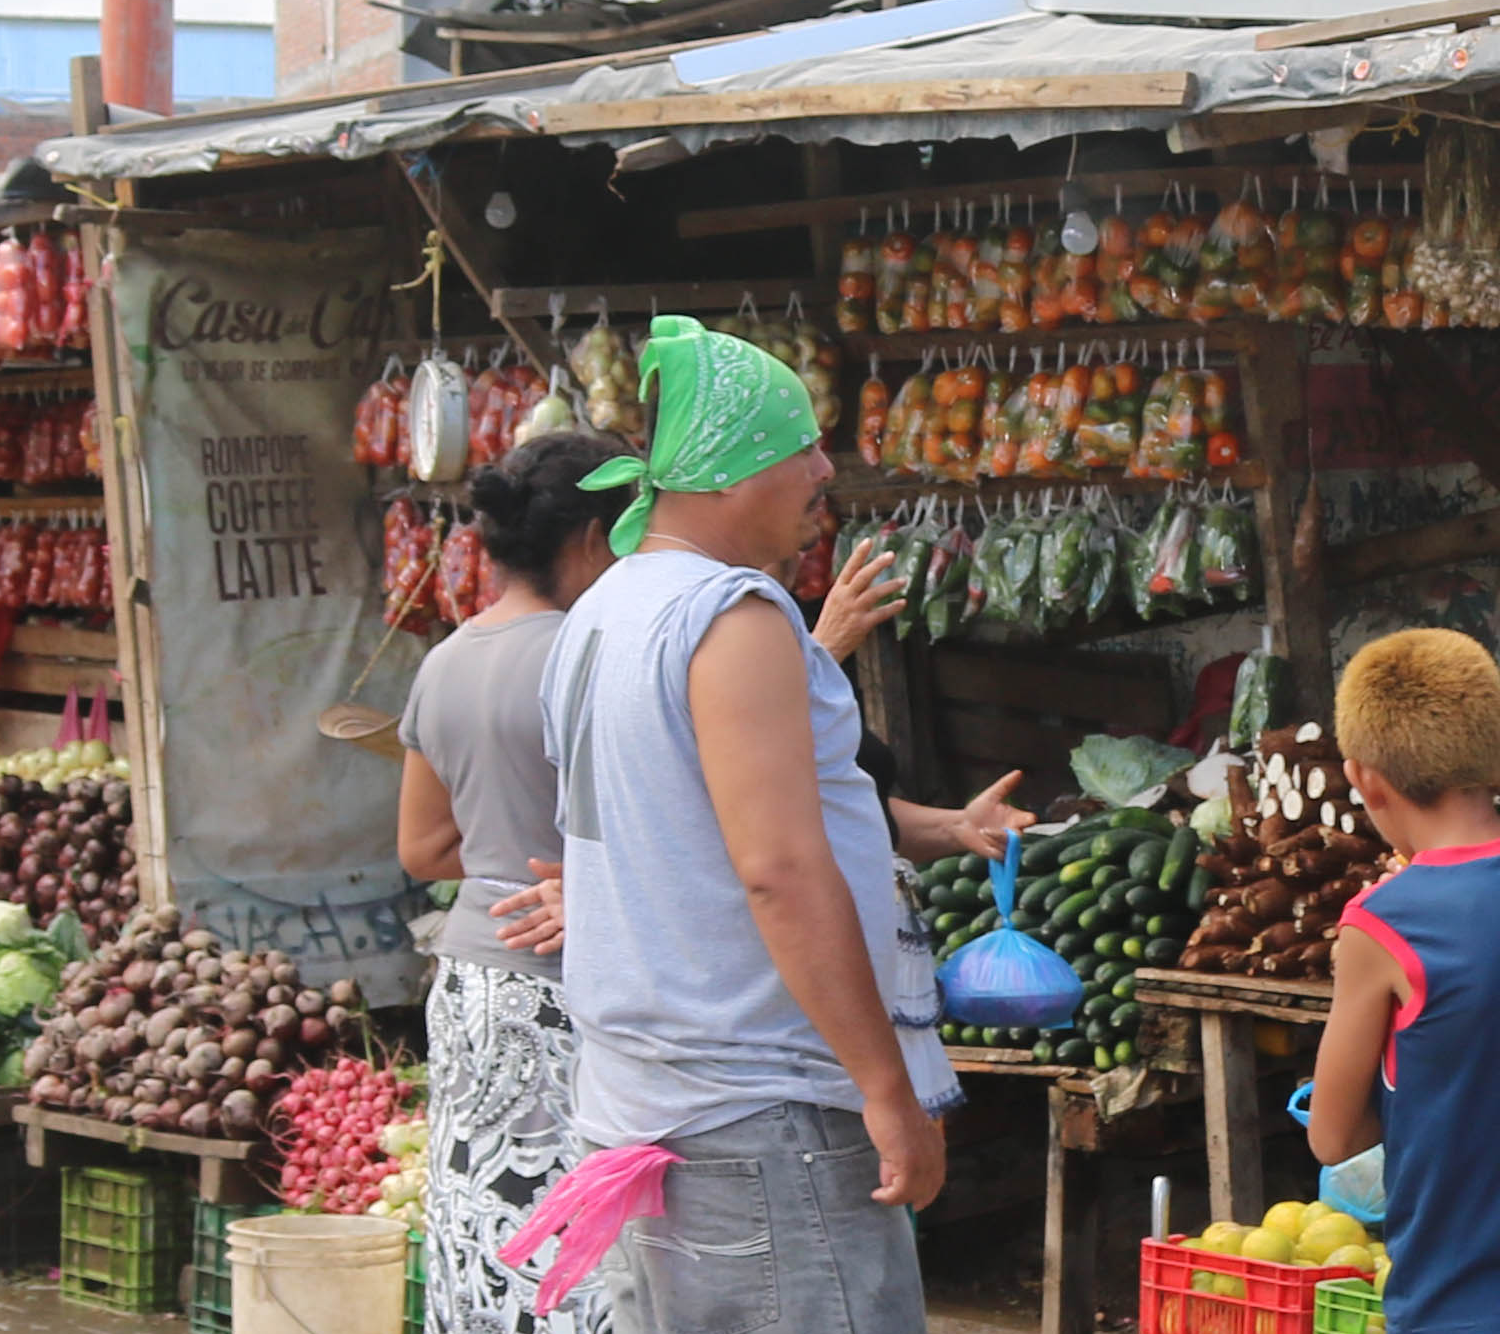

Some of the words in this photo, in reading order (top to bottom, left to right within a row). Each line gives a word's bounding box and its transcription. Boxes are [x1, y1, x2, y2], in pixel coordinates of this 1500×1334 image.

[156, 276, 280, 351] Casa
[251, 358, 267, 381] SE
[202, 434, 310, 476] ROMPOPE
[206, 478, 320, 535] COFFEE
[214, 535, 327, 602] LATTE
